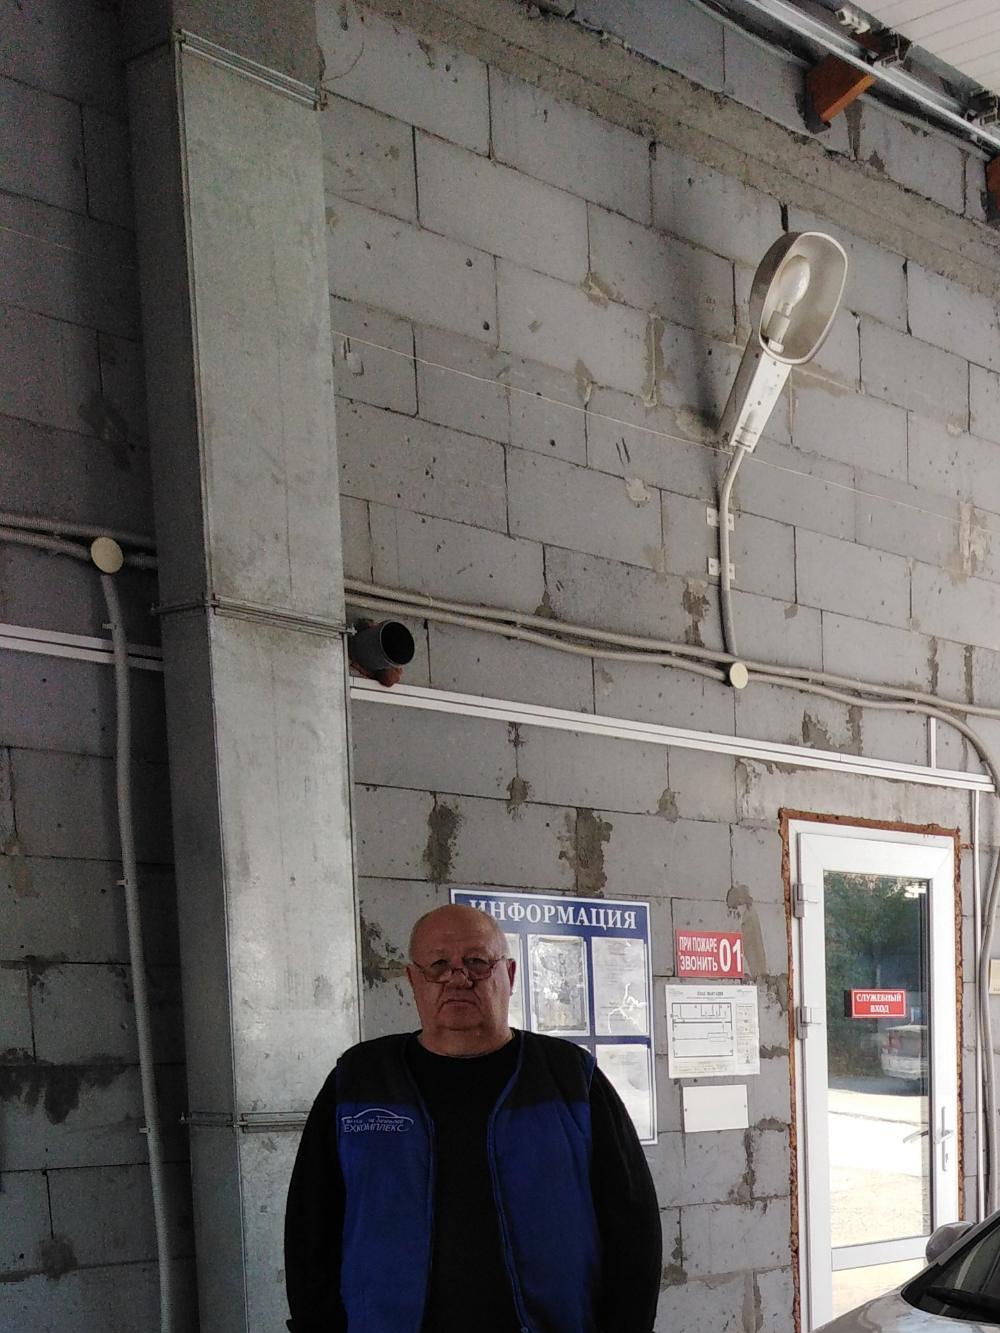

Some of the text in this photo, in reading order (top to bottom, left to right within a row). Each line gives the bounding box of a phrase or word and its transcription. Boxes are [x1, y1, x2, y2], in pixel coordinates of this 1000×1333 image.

[679, 936, 718, 953] ПРИ ПОЖАРЕ
[680, 955, 719, 972] ЗВОНИТЬ
[719, 938, 742, 973] 01
[856, 992, 902, 1002] СЛУЖЕБНЫЙ
[870, 1004, 889, 1014] ВХОД
